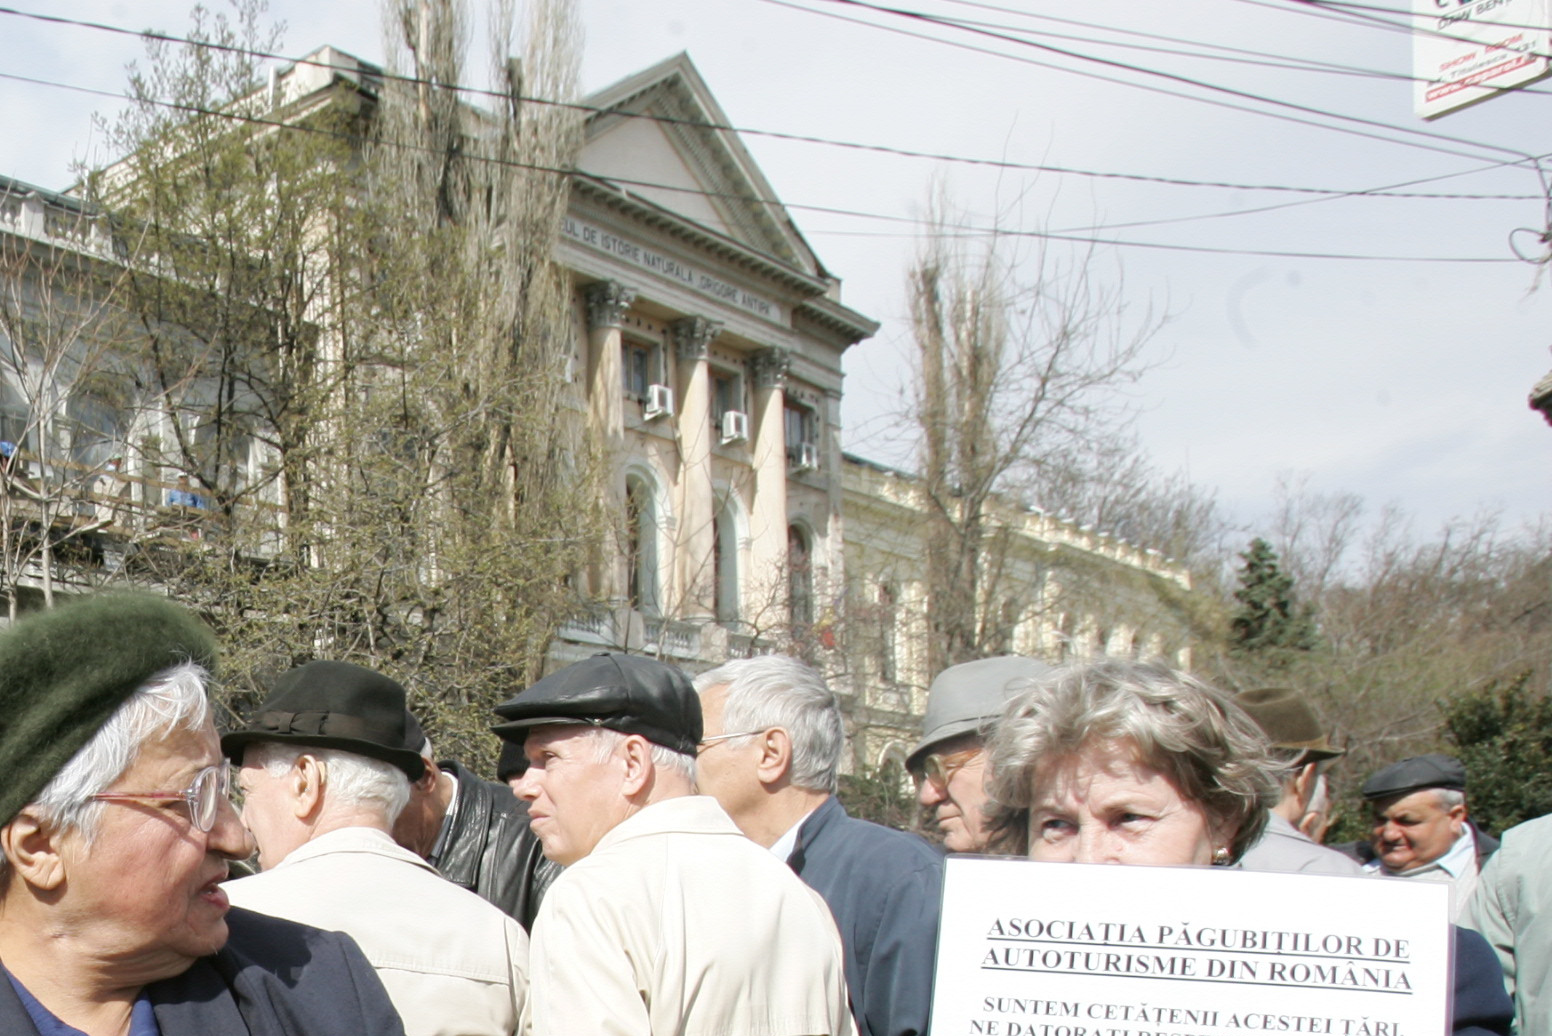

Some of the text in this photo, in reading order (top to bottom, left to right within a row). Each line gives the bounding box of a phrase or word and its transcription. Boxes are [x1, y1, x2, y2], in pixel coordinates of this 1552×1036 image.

[583, 226, 597, 245] DE
[1372, 938, 1411, 960] DE
[981, 947, 1413, 990] AUTOTURISME DIN ROMÂNIA
[982, 996, 1081, 1018] SUNTEM
[1225, 1012, 1333, 1034] ACESTEI
[969, 1019, 1000, 1036] NE
